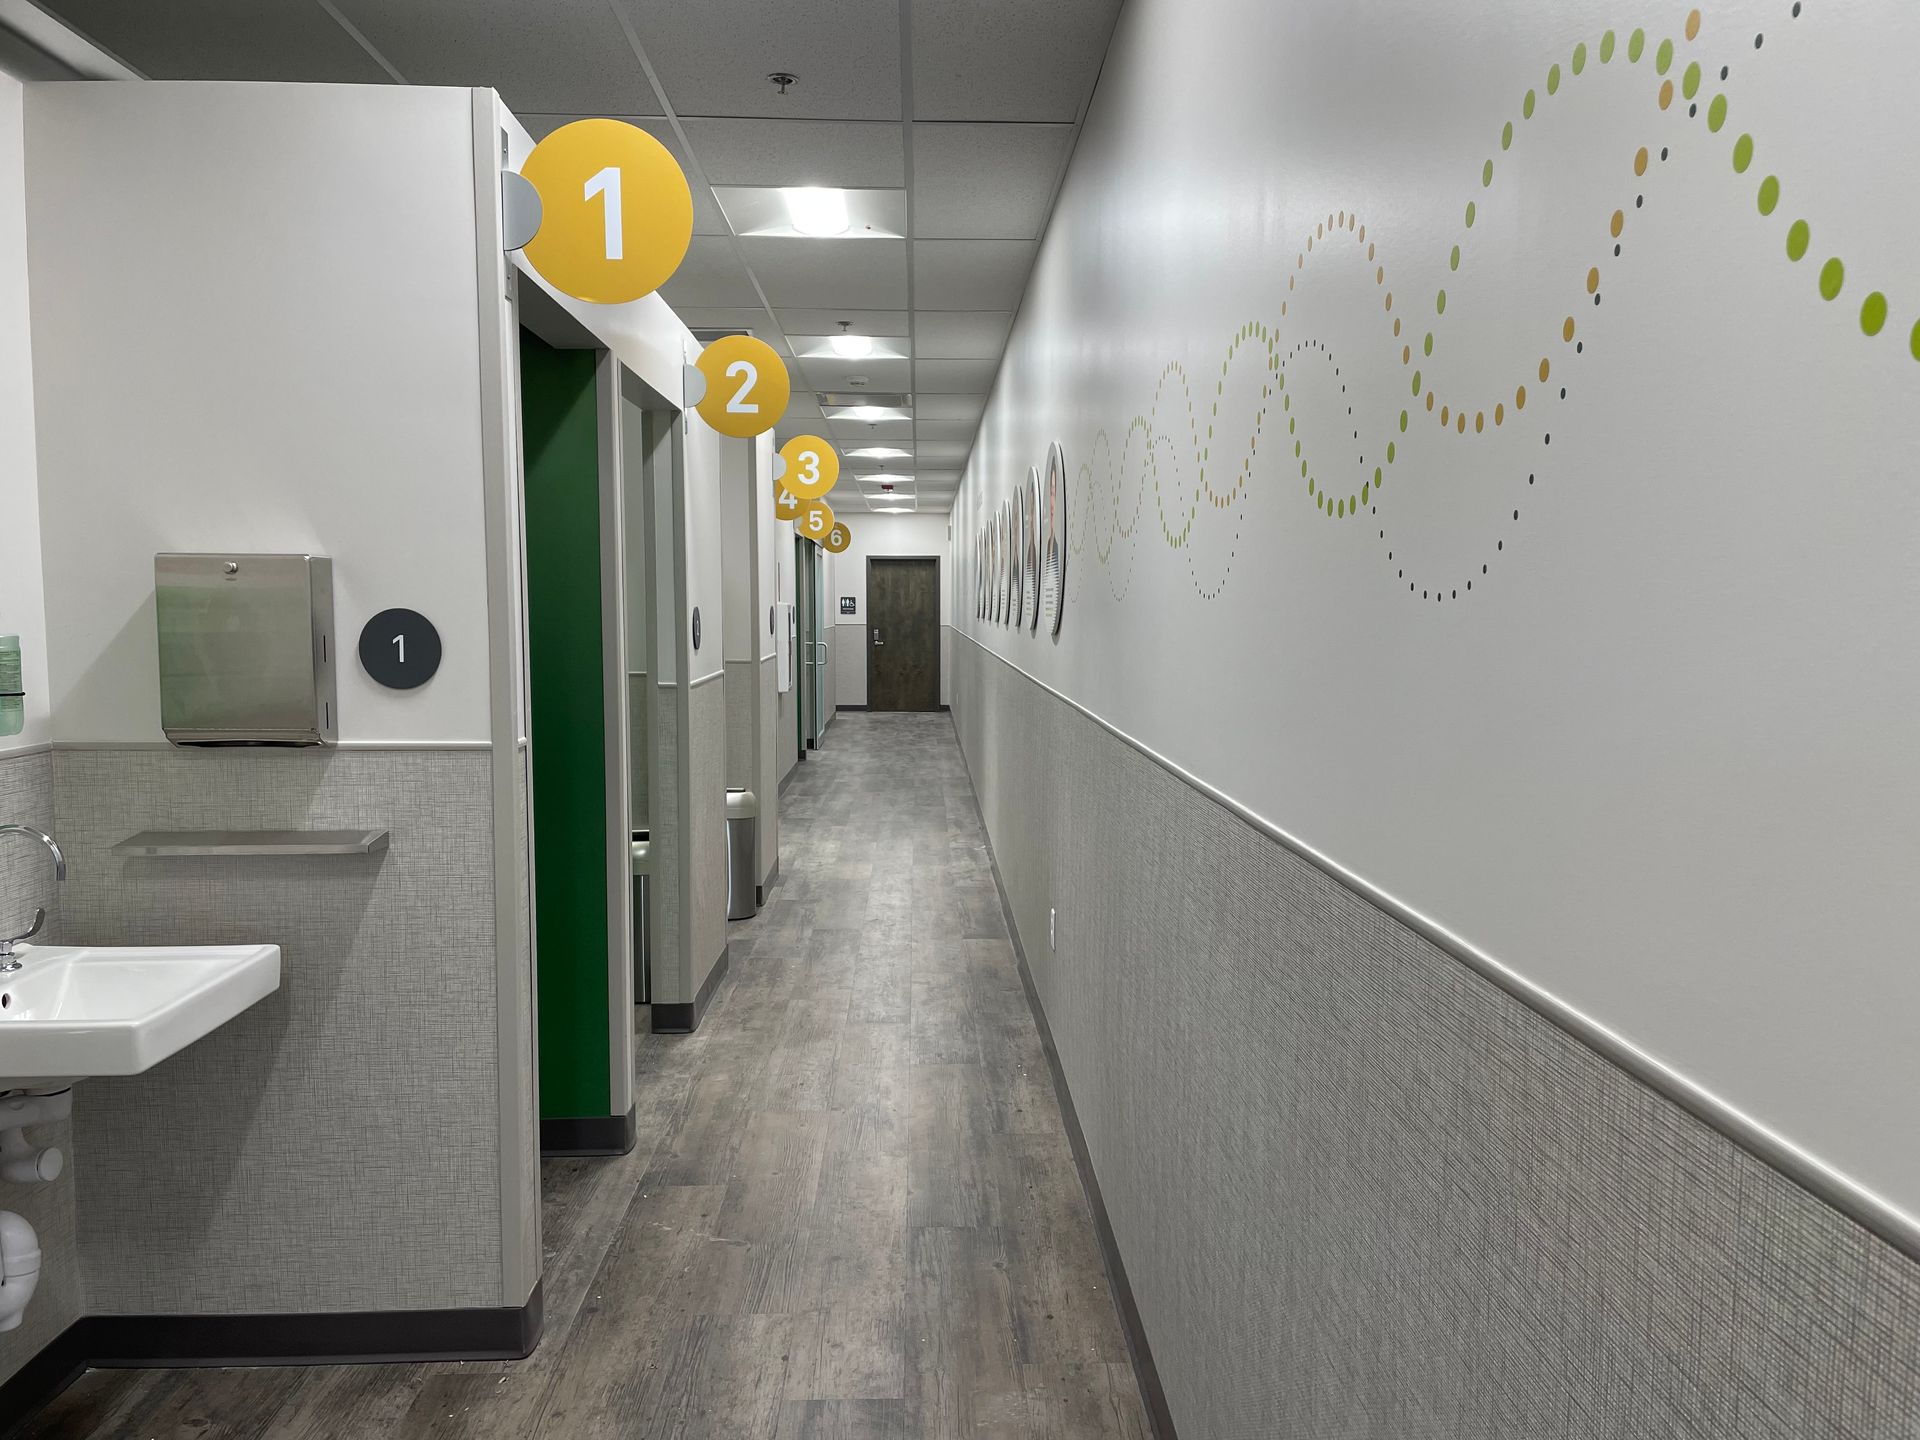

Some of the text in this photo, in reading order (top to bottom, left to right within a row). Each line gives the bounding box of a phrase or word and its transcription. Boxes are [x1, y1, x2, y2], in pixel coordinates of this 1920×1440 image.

[584, 167, 623, 260] 1
[725, 361, 759, 413] 2
[798, 451, 820, 485] 3
[778, 488, 798, 509] 4
[809, 510, 823, 531] 5
[830, 529, 842, 546] 6
[392, 634, 405, 662] 1
